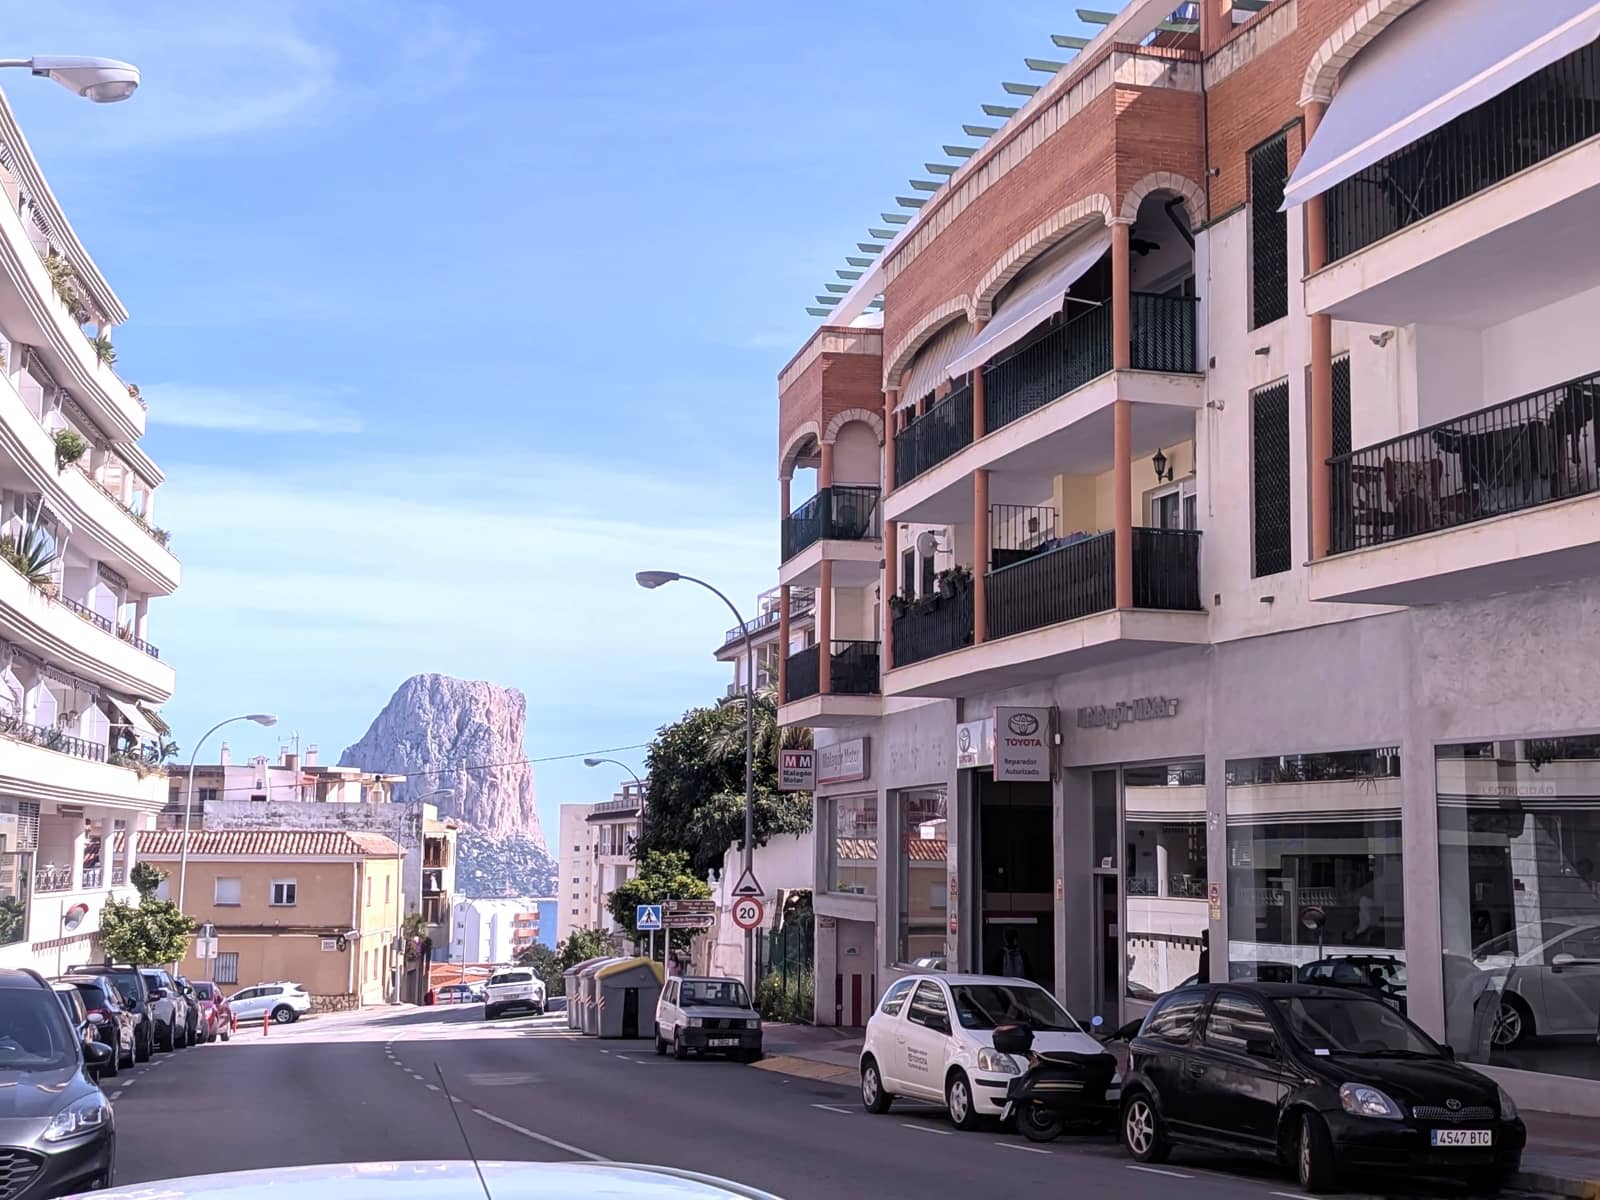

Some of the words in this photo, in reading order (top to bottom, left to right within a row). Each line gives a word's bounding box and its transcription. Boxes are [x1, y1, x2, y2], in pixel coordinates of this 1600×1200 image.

[1004, 738, 1042, 747] TOYOTA
[1004, 758, 1037, 767] Reparador
[1005, 768, 1040, 776] Autorizado
[740, 907, 756, 919] 20
[1440, 1131, 1466, 1144] 4547
[1470, 1131, 1489, 1144] BTC
